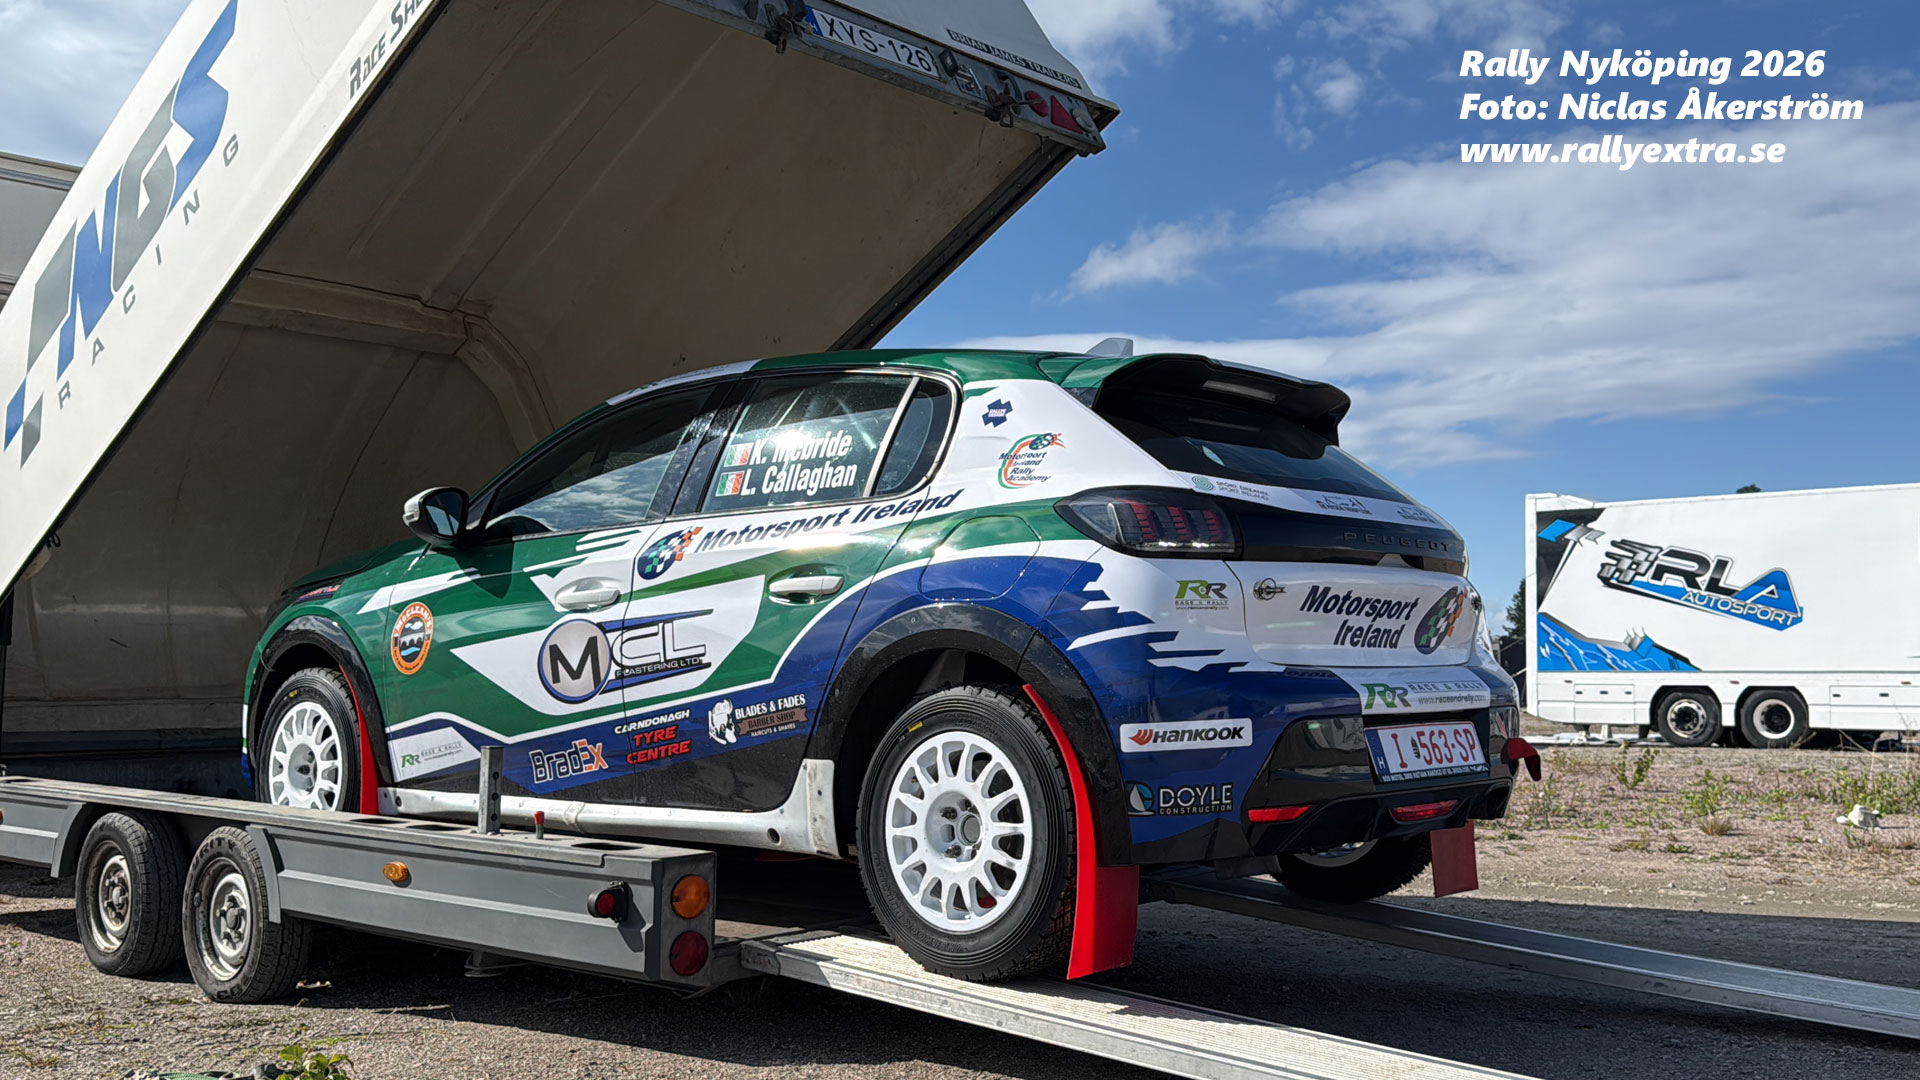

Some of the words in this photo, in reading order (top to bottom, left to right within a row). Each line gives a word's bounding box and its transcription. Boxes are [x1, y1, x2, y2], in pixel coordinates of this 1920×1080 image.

[821, 14, 932, 72] XYS-126
[951, 31, 988, 52] BRIAN
[989, 45, 1026, 67] JAMES
[1027, 61, 1080, 87] TRAILERS
[57, 133, 239, 410] RACING
[749, 438, 767, 465] K.
[741, 469, 756, 496] L.
[761, 461, 858, 496] Callaghan
[1010, 467, 1035, 475] Rally
[694, 507, 852, 553] Motorsport
[851, 488, 965, 524] Ireland
[1343, 531, 1449, 552] PEUGEOT
[1299, 585, 1420, 620] Motorsport
[1681, 591, 1797, 626] AUTOSPORT
[1333, 620, 1405, 649] Ireland
[1408, 683, 1439, 693] RACE
[1455, 681, 1486, 690] RALLY
[735, 702, 767, 719] BLADES
[770, 700, 776, 712] &
[778, 694, 806, 710] FADES
[614, 709, 690, 734] CARNDONAGH
[748, 714, 776, 729] BARBER
[777, 711, 796, 722] SHOP
[751, 727, 772, 737] HAIRCUTS
[633, 726, 677, 747] TYRE
[1153, 726, 1245, 744] HANKOOK
[627, 740, 692, 764] CENTRE
[1377, 756, 1386, 770] H
[1391, 733, 1408, 769] I
[1160, 785, 1232, 807] DOYLE
[1160, 805, 1232, 815] CONSTRUCTION
